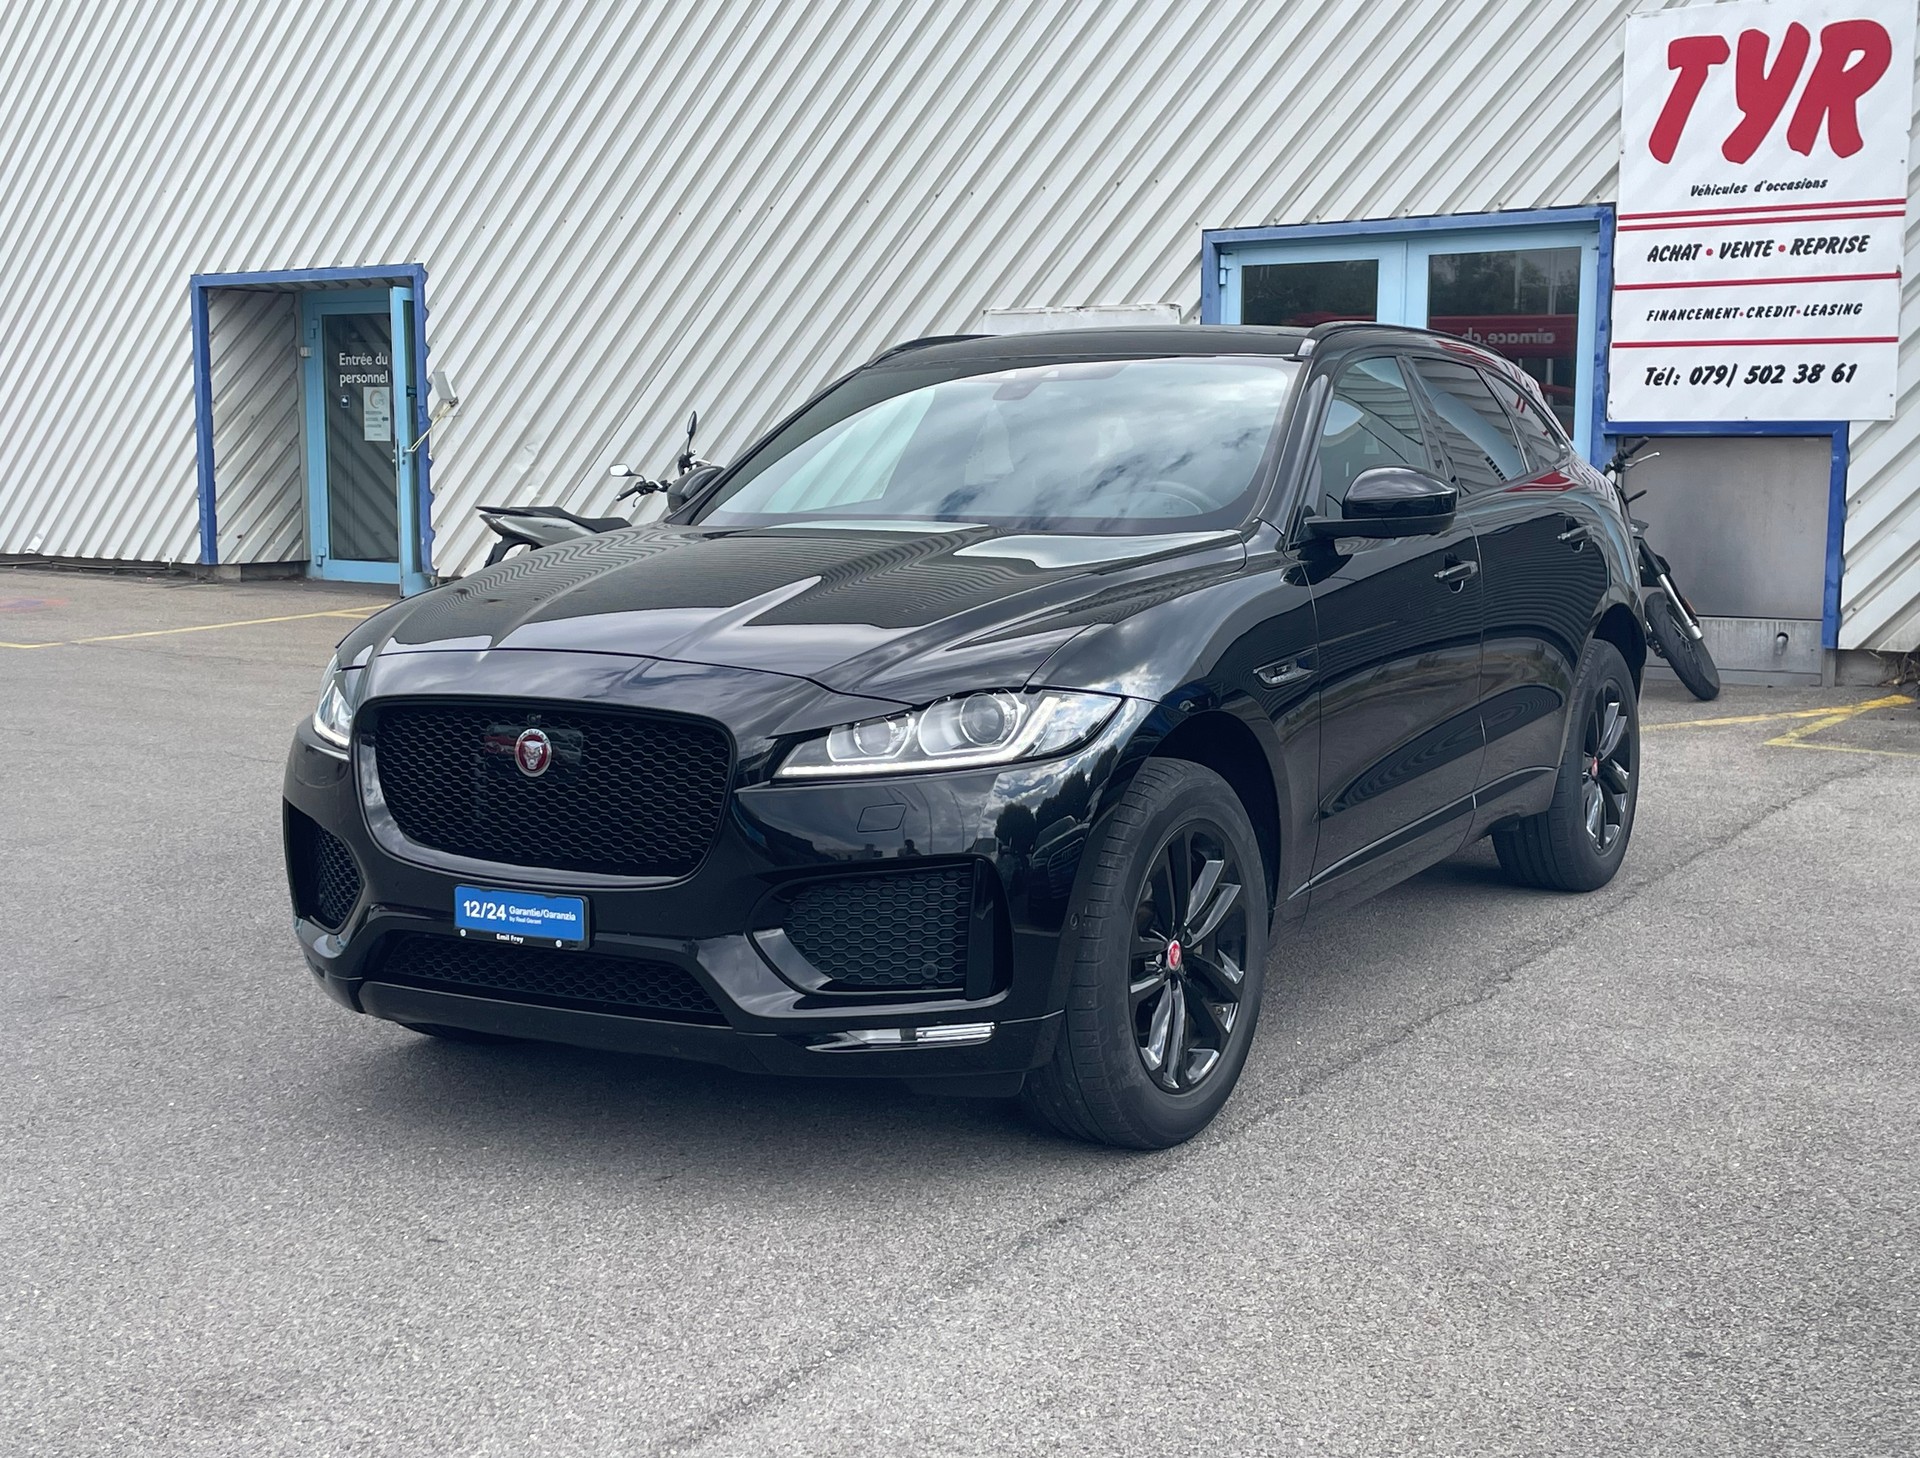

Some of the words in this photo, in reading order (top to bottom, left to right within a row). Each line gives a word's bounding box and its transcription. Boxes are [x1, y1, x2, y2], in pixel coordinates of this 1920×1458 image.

[1648, 19, 1893, 165] TYR
[1690, 182, 1748, 197] Véhicules
[1753, 177, 1829, 194] d'occasions
[1646, 243, 1703, 263] ACHAT
[1718, 239, 1775, 260] VENTE
[1789, 234, 1871, 256] REPRISE
[1646, 306, 1739, 322] FINANCEMENT
[1745, 305, 1797, 319] CREDIT
[1802, 302, 1863, 317] LEASING
[339, 352, 373, 366] Entrée
[375, 352, 388, 365] du
[340, 370, 389, 387] personnel
[1644, 366, 1681, 387] Tél:
[1743, 364, 1786, 385] 502
[1792, 363, 1826, 385] 38
[1830, 362, 1858, 384] 61
[463, 900, 507, 921] 12/24
[496, 933, 509, 942] Emil
[511, 935, 524, 944] Frey
